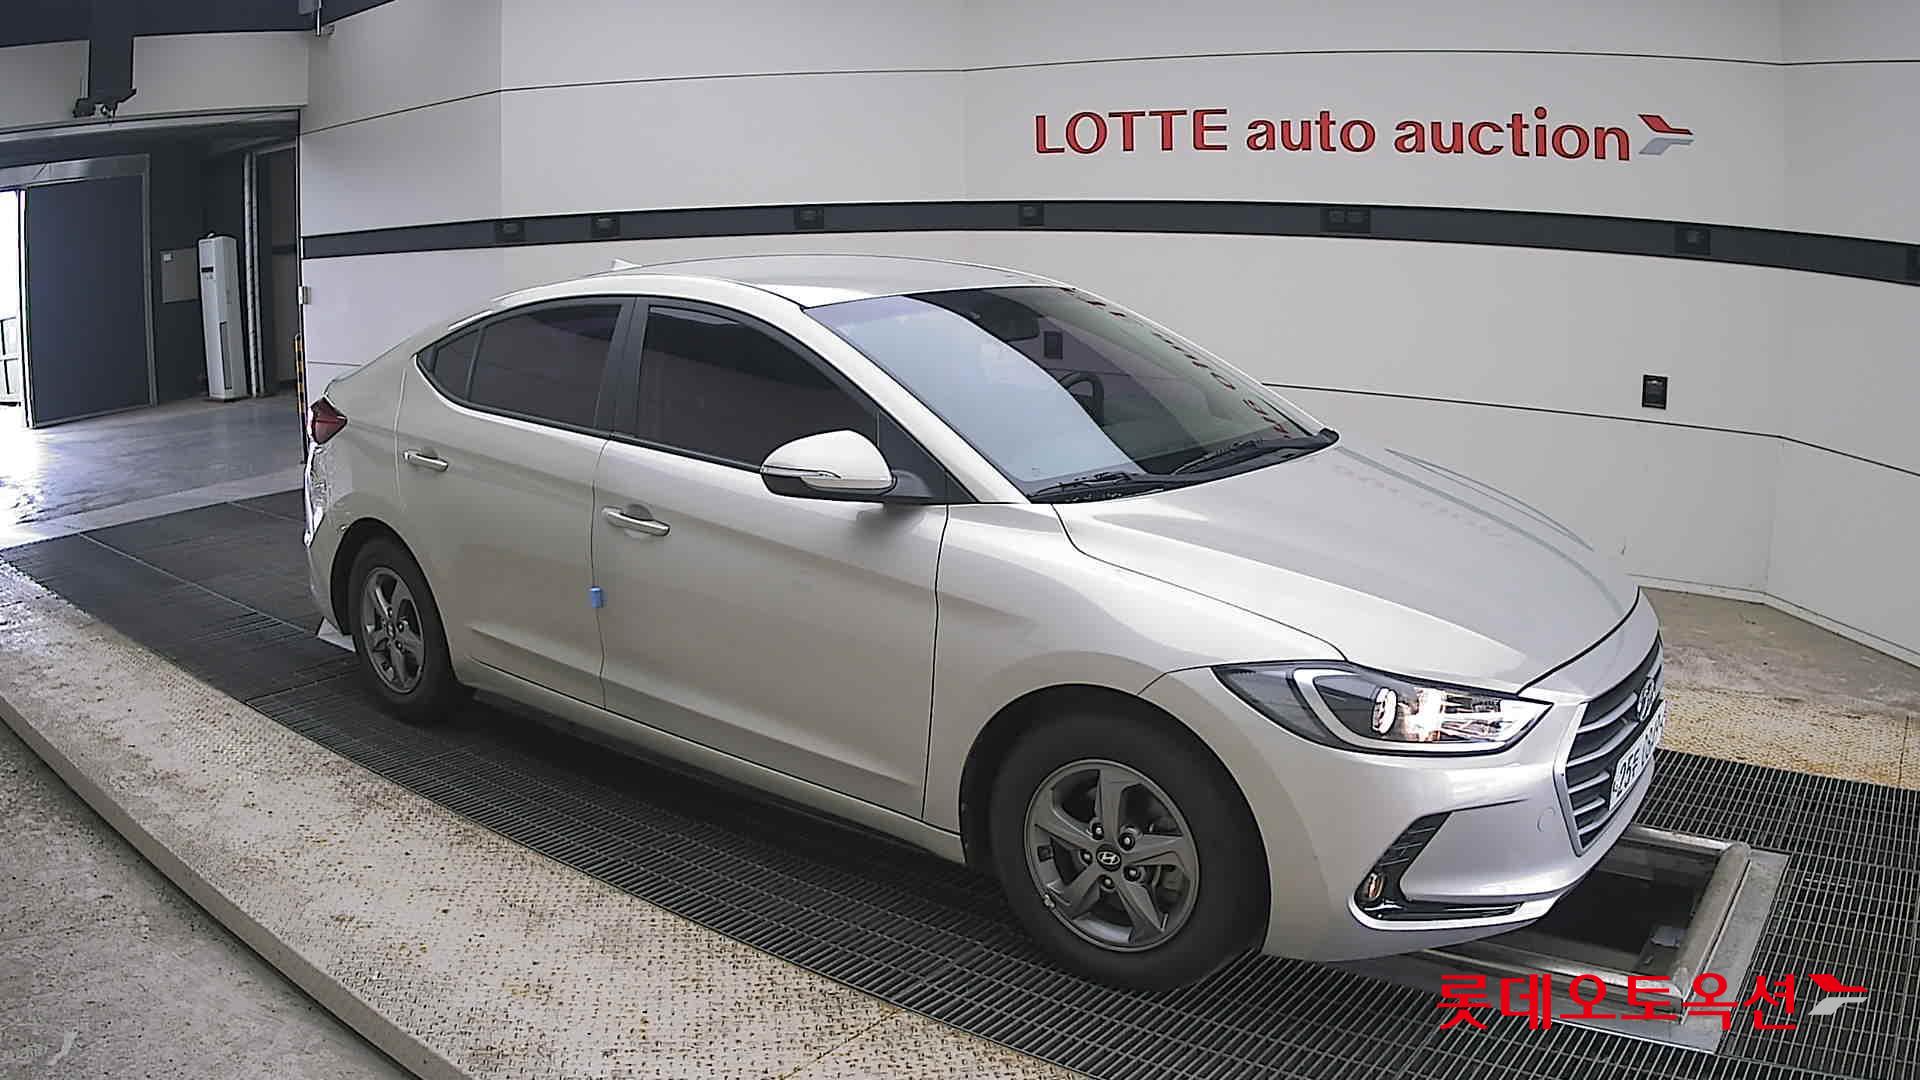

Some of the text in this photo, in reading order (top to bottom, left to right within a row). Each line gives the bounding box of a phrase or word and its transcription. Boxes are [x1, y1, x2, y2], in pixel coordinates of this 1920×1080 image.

[1035, 107, 1630, 160] LOTTE auto auction
